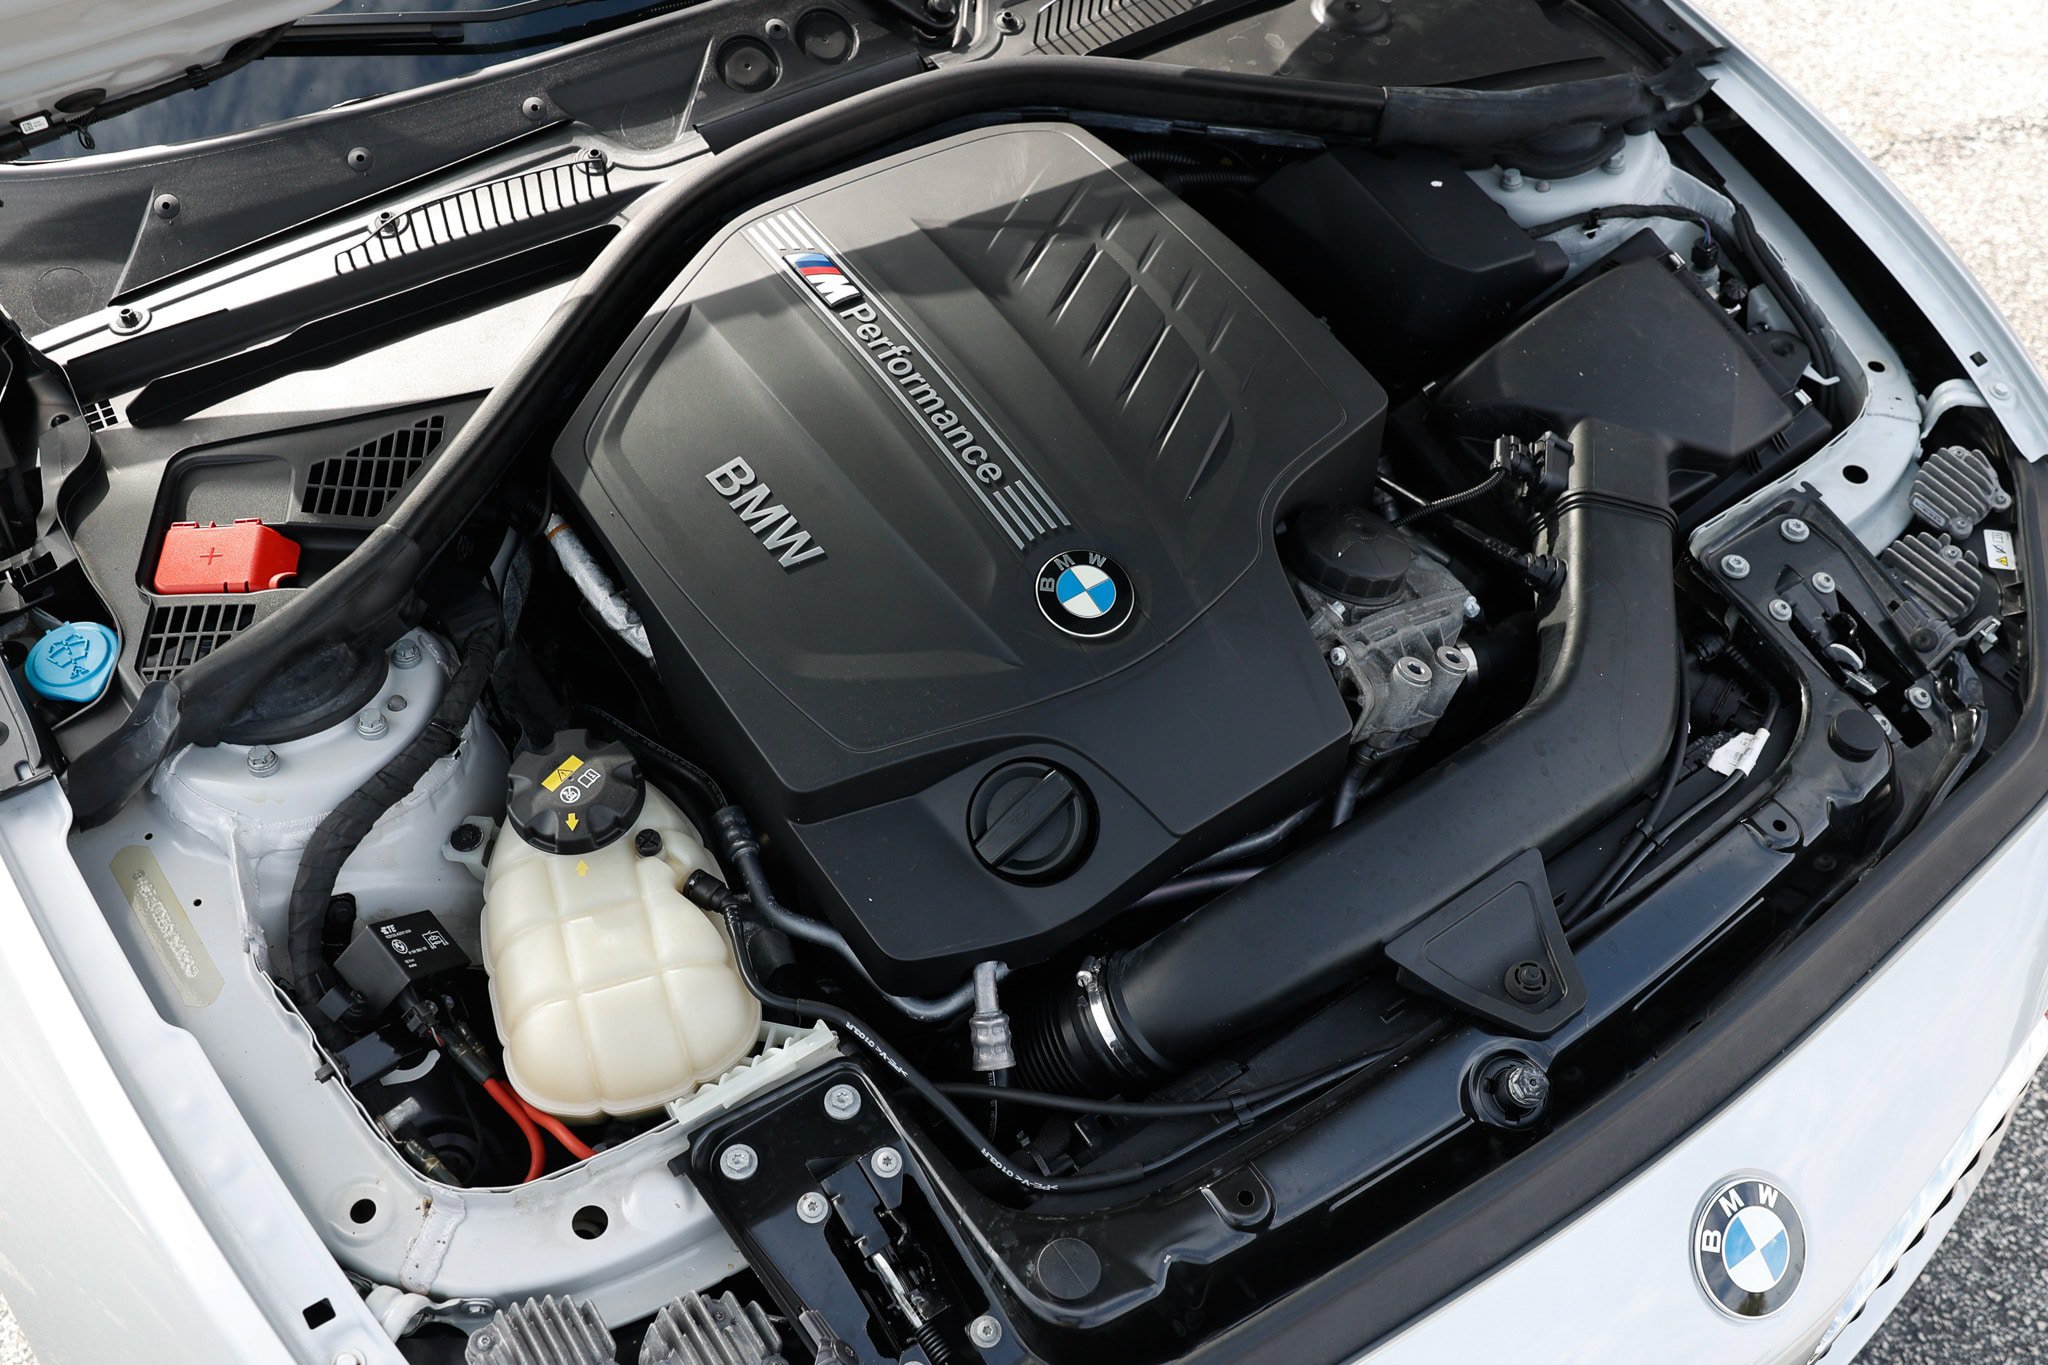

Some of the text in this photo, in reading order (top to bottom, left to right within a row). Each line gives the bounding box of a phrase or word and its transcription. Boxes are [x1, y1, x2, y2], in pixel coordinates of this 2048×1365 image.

[839, 302, 1003, 484] Performance
[704, 455, 826, 568] BMW
[1040, 552, 1107, 592] BMW
[1701, 1183, 1779, 1254] BMW
